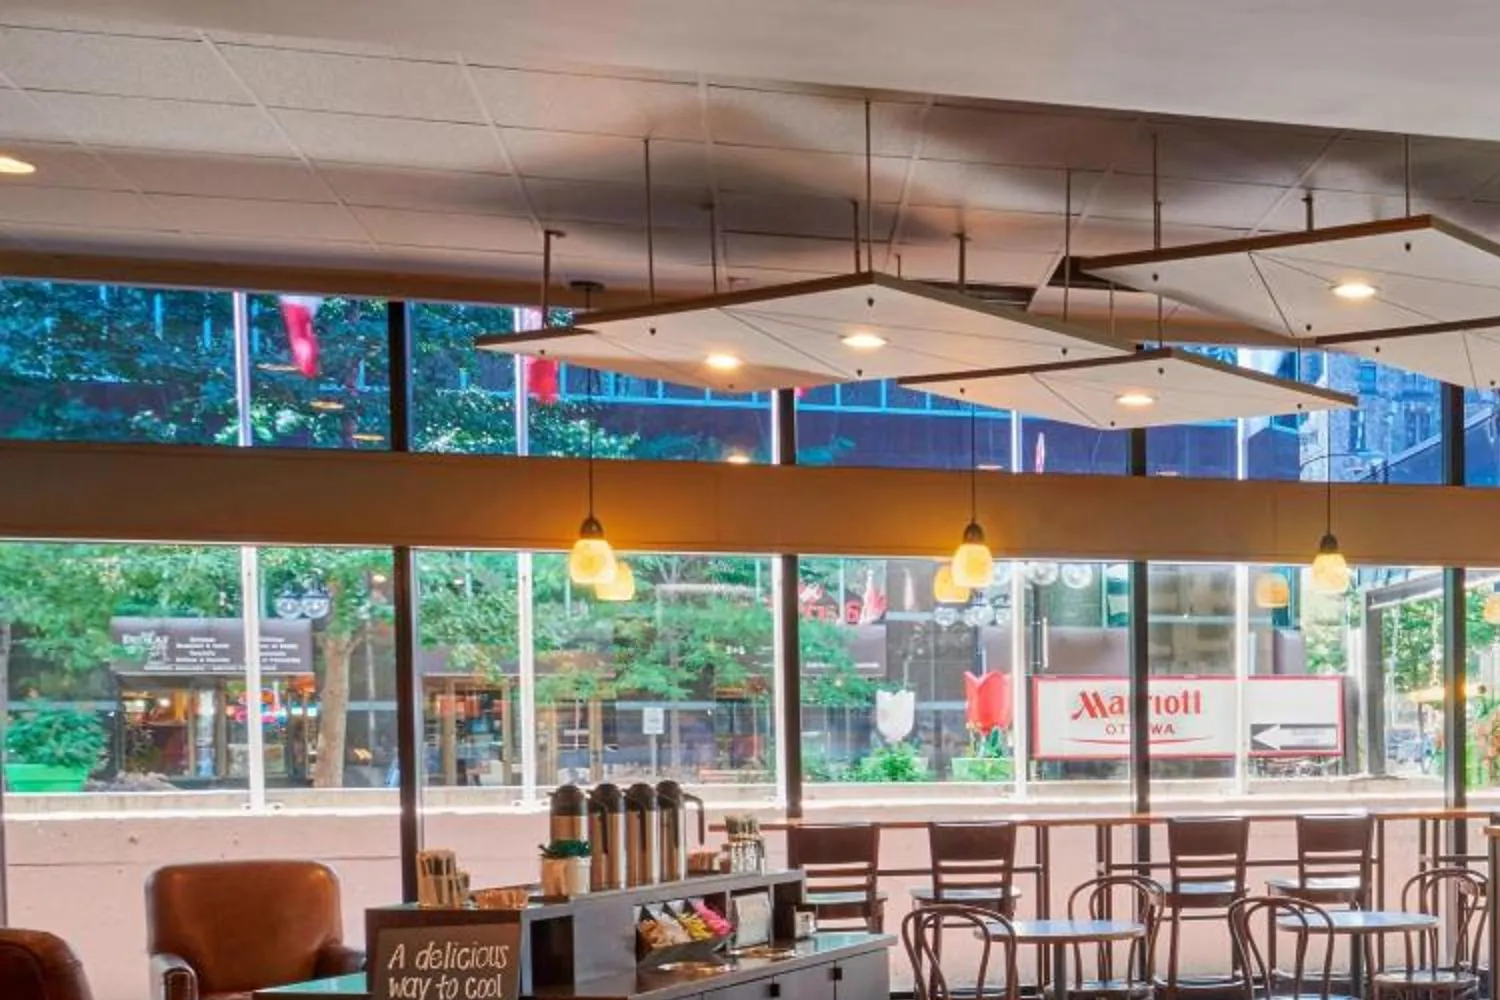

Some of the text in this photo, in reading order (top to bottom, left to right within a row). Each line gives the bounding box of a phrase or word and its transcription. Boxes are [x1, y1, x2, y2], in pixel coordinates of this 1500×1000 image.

[1071, 689, 1202, 721] Maiott
[1105, 723, 1176, 736] OTWA
[387, 939, 510, 971] A delicious
[464, 973, 504, 1000] cool
